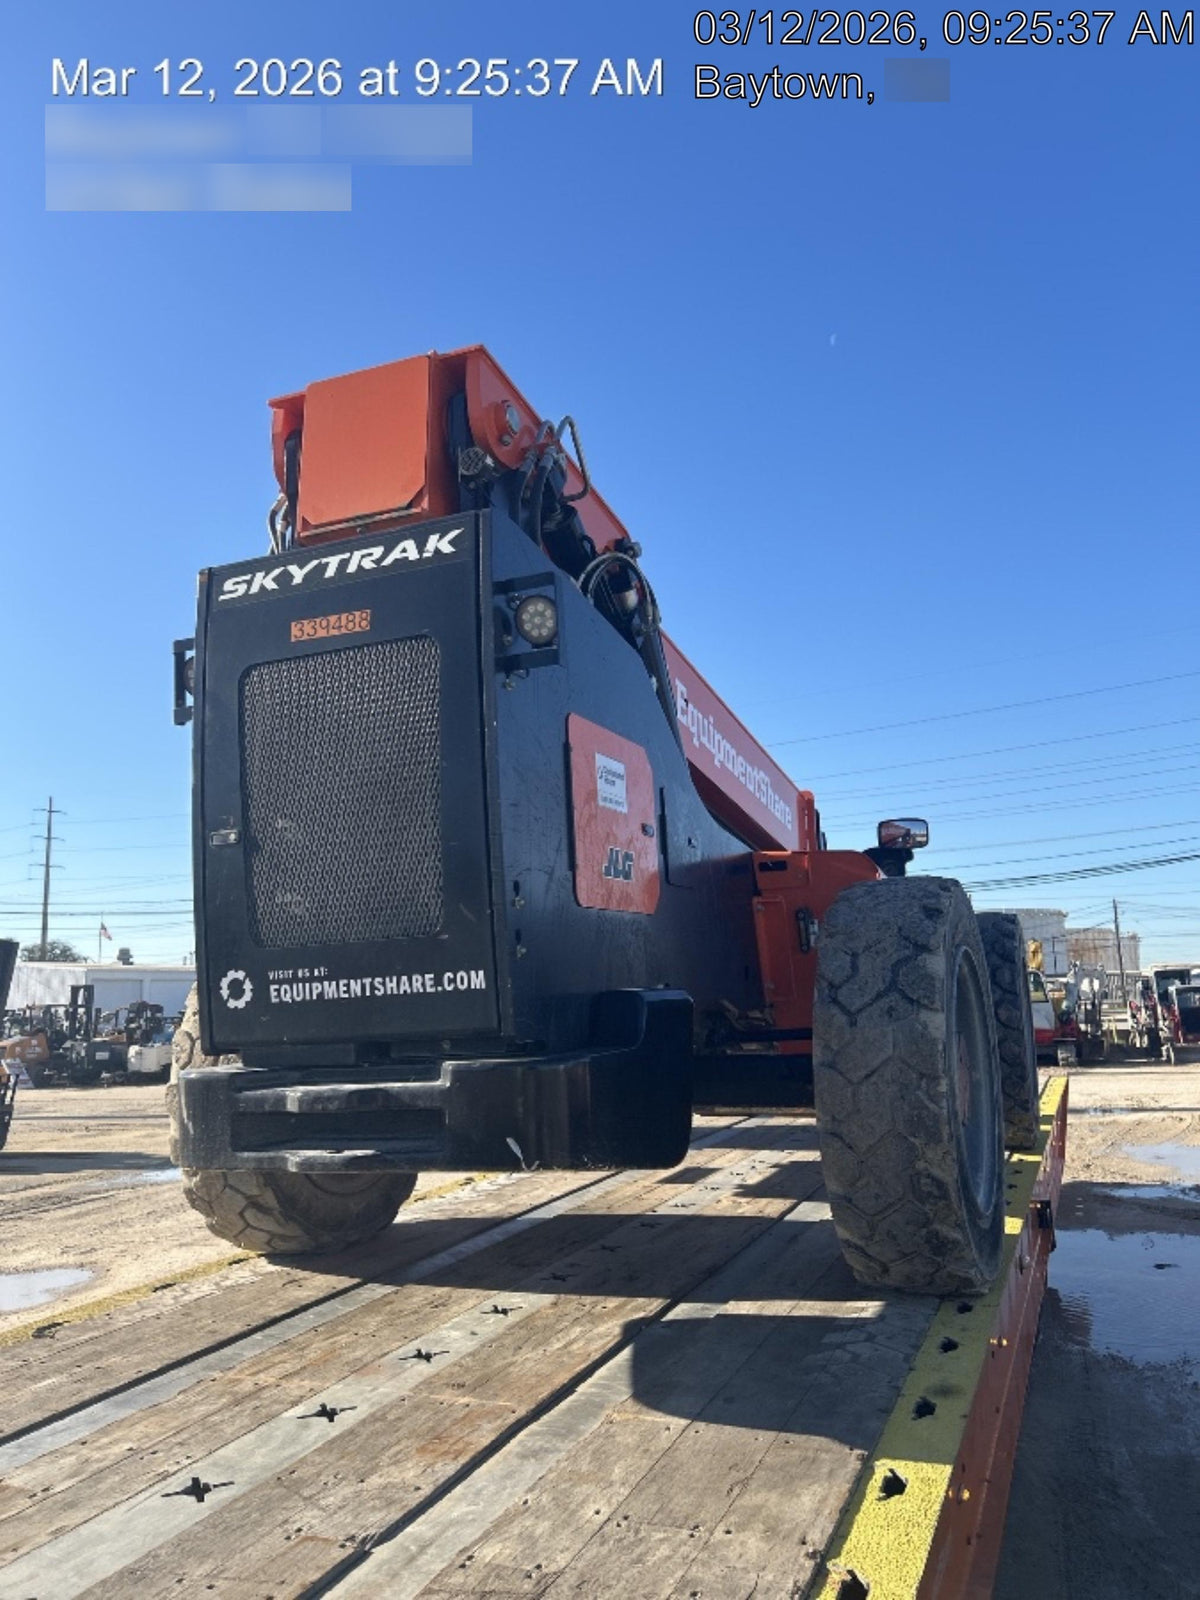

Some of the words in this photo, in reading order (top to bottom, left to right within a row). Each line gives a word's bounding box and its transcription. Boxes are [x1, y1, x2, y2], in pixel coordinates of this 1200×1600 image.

[218, 527, 465, 602] SKYTRAK
[292, 612, 371, 639] 339488
[675, 677, 793, 832] EquipmentShare
[603, 847, 635, 882] JLG
[269, 969, 486, 1004] EQUIPMENTSHARE.COM
